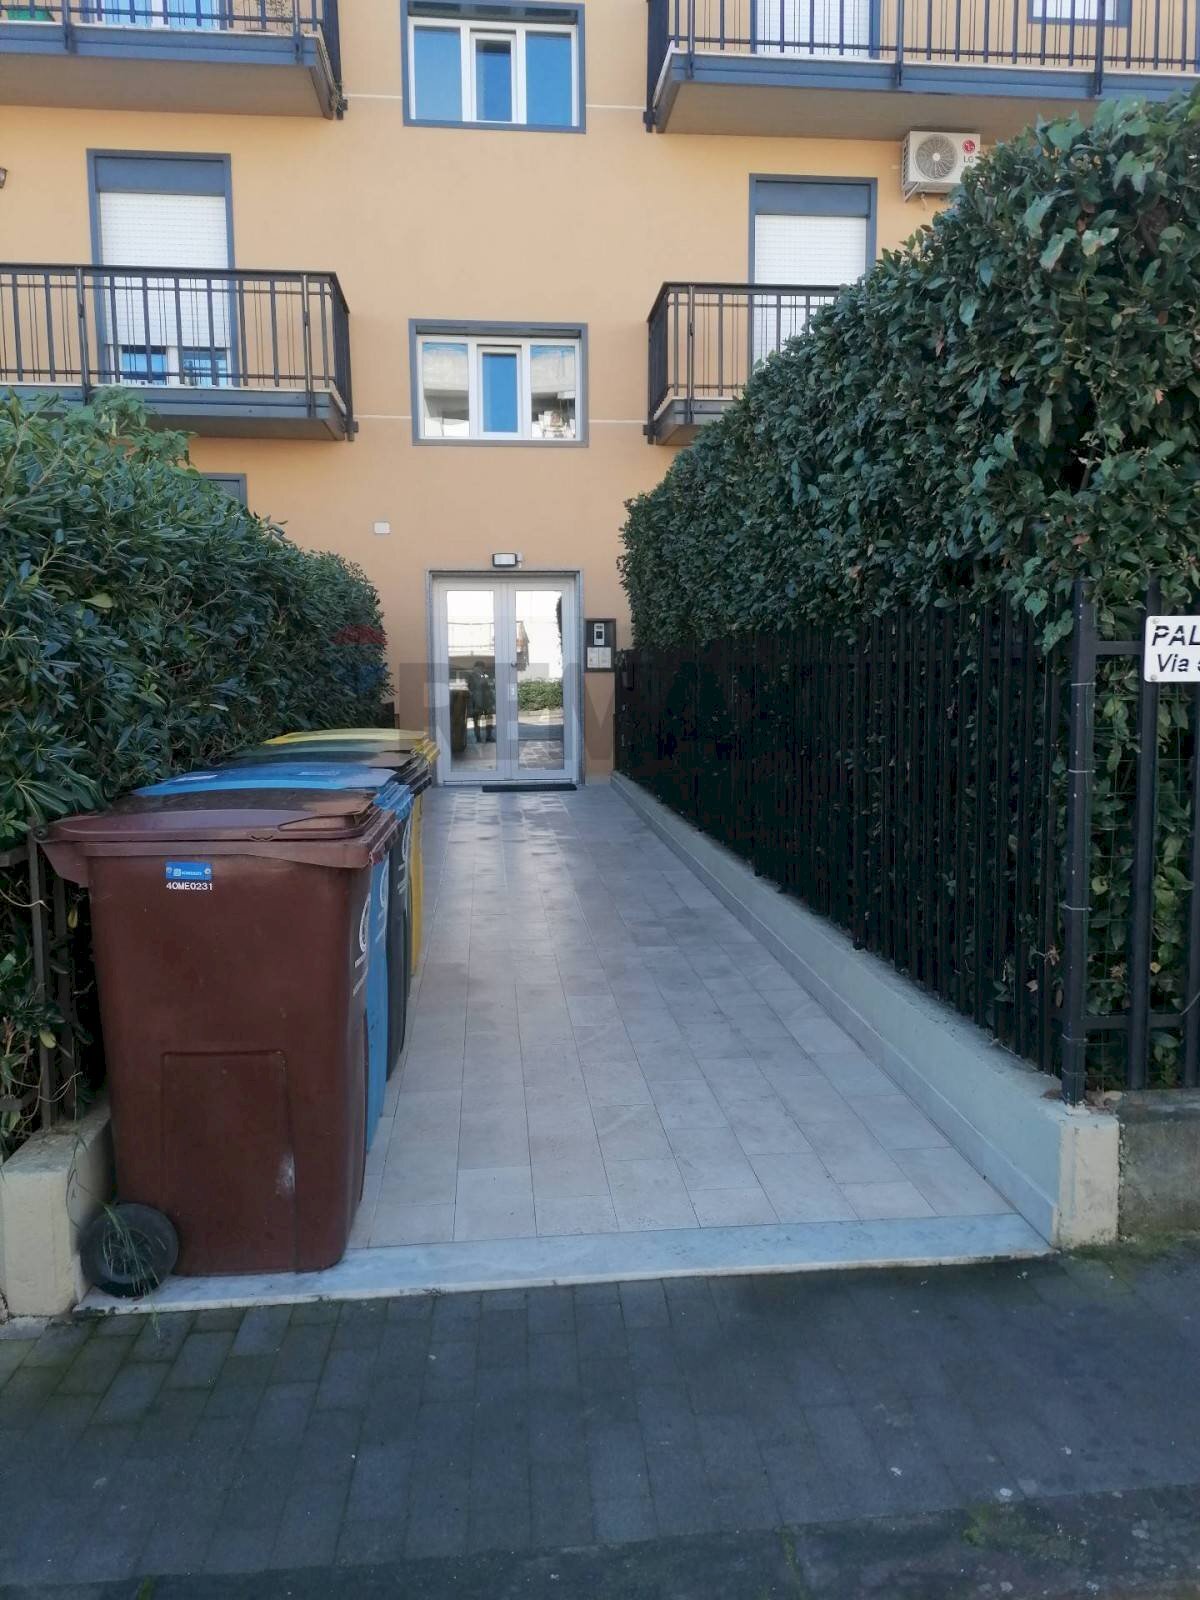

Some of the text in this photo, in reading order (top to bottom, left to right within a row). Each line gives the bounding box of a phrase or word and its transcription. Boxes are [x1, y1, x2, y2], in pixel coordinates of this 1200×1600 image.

[963, 155, 974, 163] LG
[1151, 624, 1200, 646] PAL
[1157, 653, 1190, 673] Via
